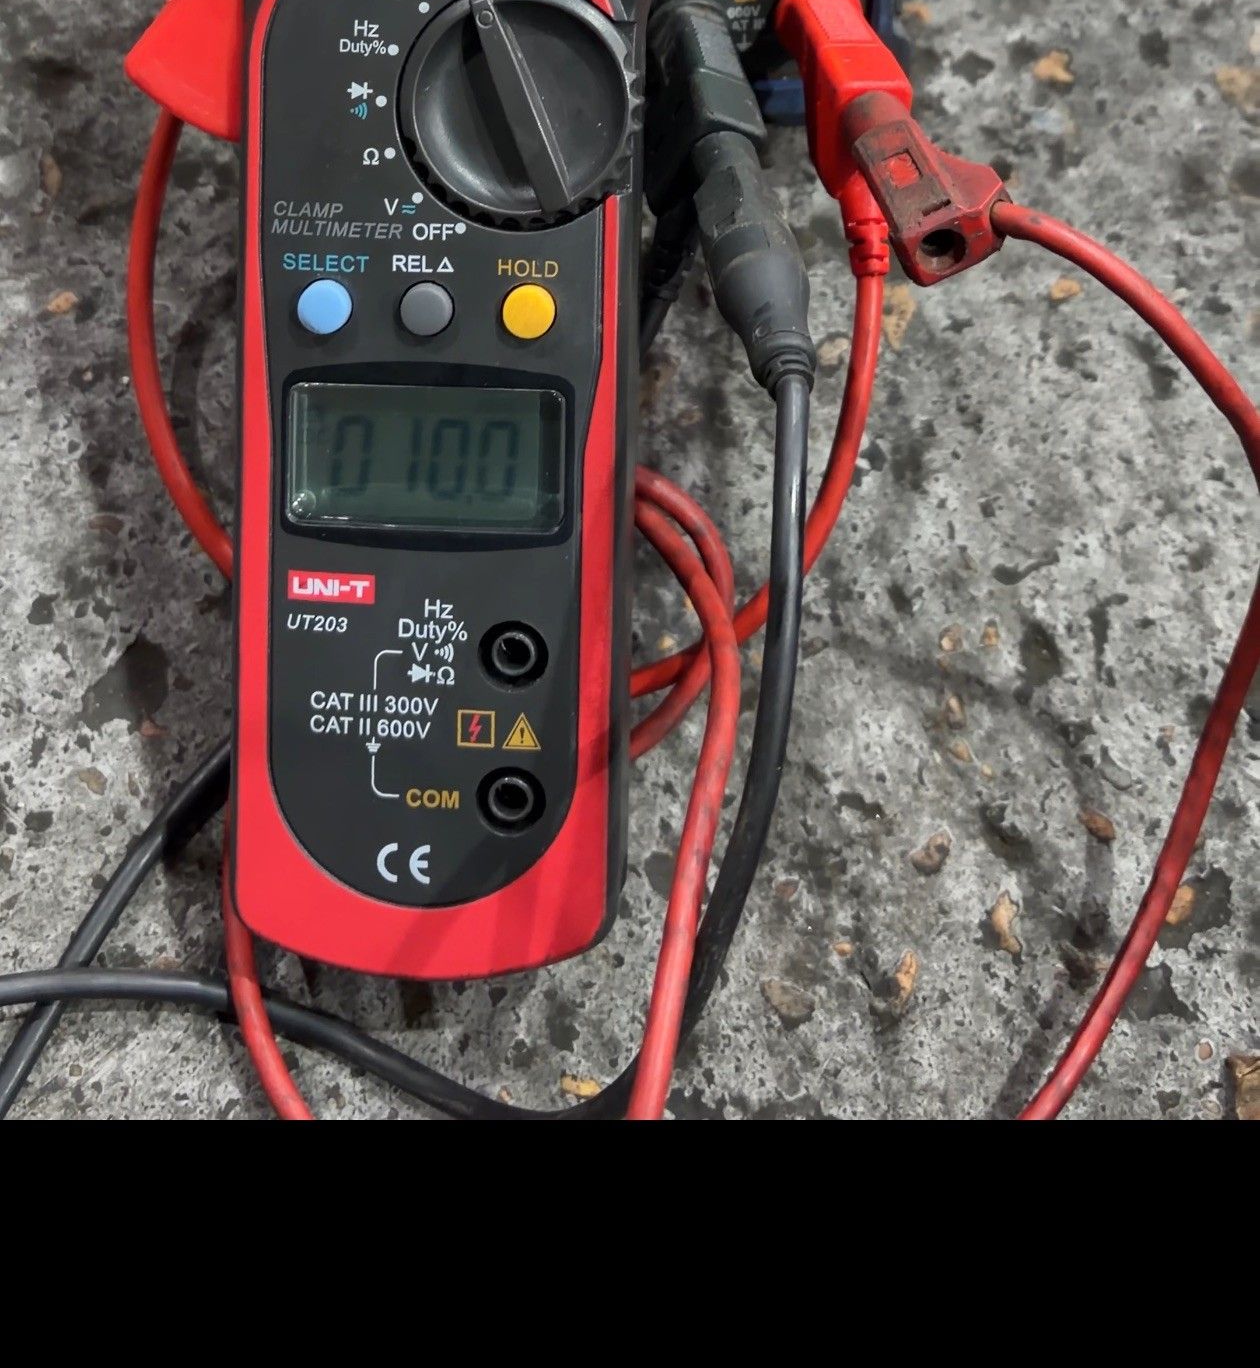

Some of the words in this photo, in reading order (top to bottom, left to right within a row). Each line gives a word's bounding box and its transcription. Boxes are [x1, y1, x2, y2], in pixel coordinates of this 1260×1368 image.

[353, 19, 380, 38] Hz
[339, 38, 387, 57] Duty%
[273, 201, 344, 219] CLAMP
[271, 218, 403, 240] MULTIMETER
[412, 223, 454, 241] OFF
[283, 253, 369, 273] SELECT
[497, 258, 559, 278] HOLD
[292, 576, 370, 598] UNI-T
[424, 598, 453, 619] Hz
[287, 613, 348, 633] UT203
[398, 618, 468, 644] Duty%
[411, 642, 428, 661] V
[310, 690, 353, 710] CAT
[384, 695, 438, 716] 300V
[309, 714, 353, 735] CAT
[377, 719, 431, 740] 600V
[406, 788, 461, 809] COM
[377, 842, 431, 885] CE
